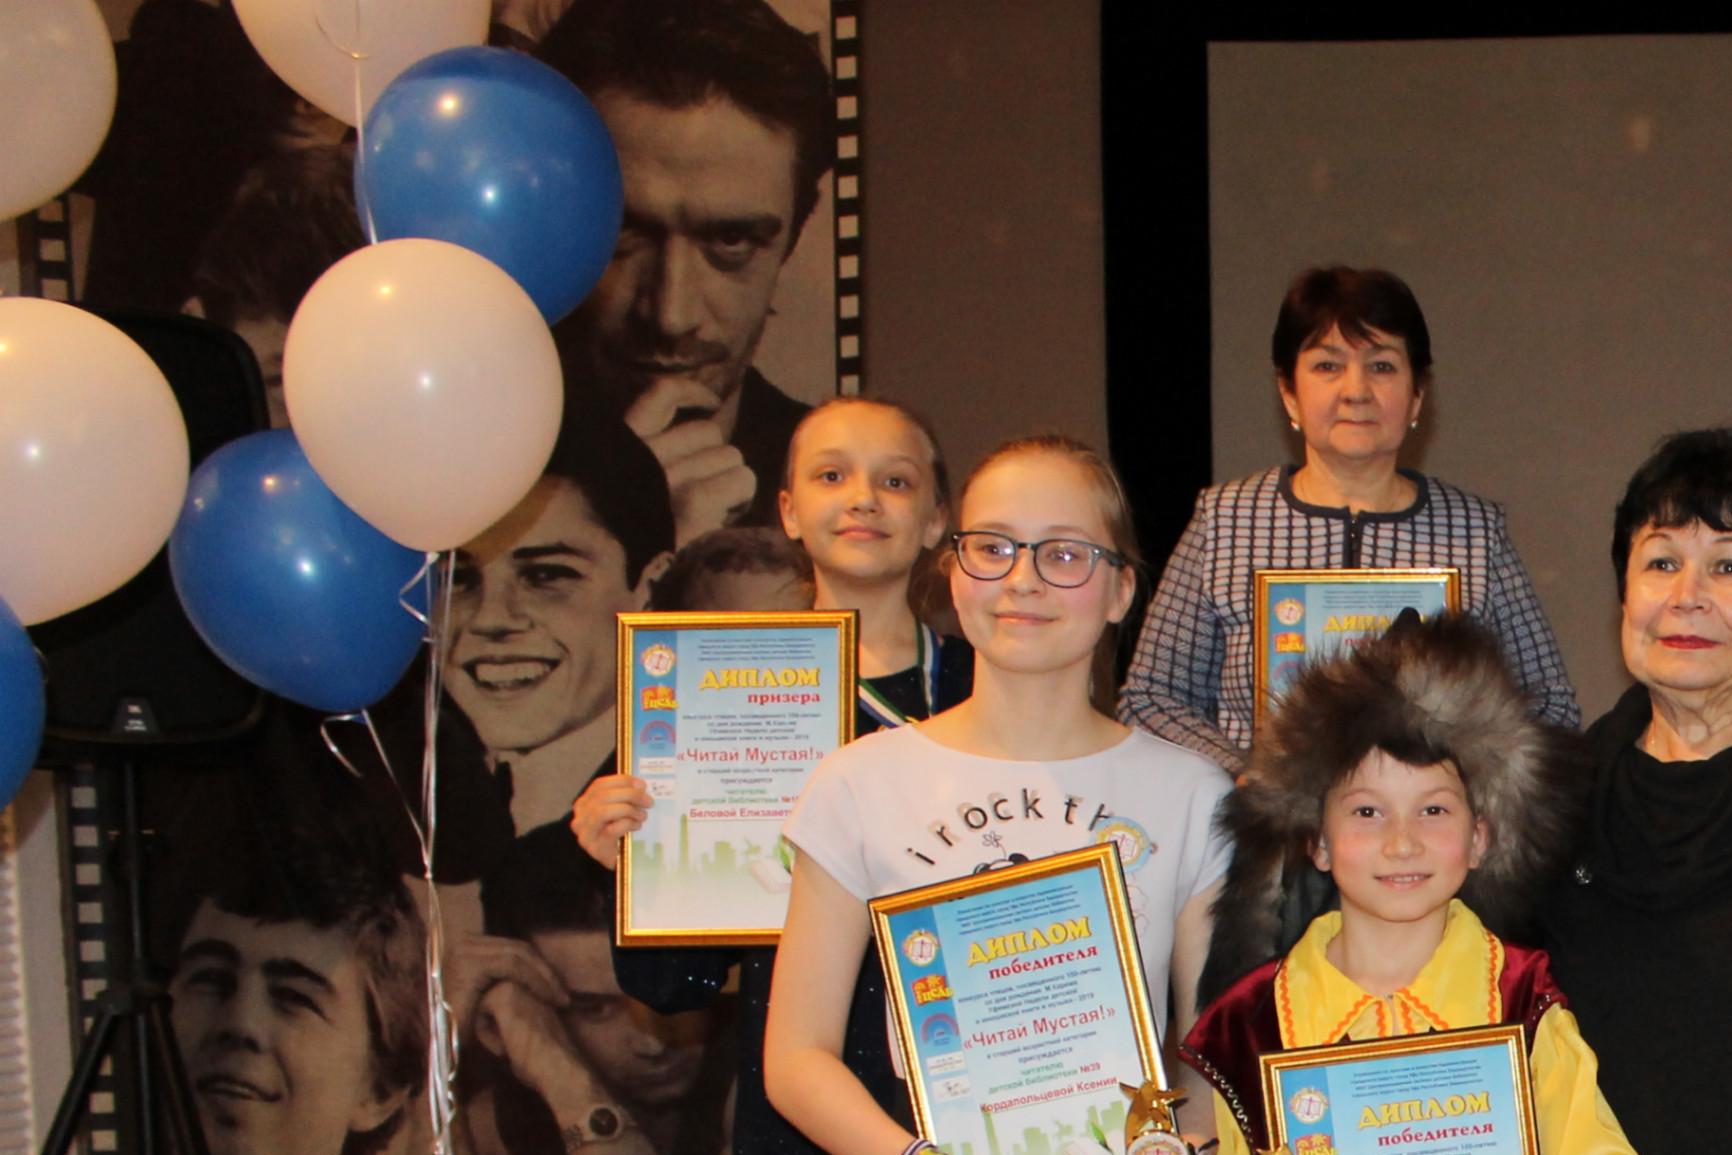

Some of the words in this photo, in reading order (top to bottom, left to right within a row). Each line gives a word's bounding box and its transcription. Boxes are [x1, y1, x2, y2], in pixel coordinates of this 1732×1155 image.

[699, 666, 820, 690] ДИПЛОМ
[747, 692, 820, 705] призера
[676, 748, 738, 761] «Читай
[745, 747, 824, 764] Мустая!»
[740, 808, 791, 817] Елизавет
[935, 787, 1044, 848] rock
[964, 918, 1093, 965] ДИПЛОМ
[987, 947, 1097, 979] победителя
[962, 1022, 1028, 1049] «Читай
[1031, 1003, 1117, 1037] Мустая!»
[1356, 1092, 1491, 1128] ДИПЛОМ
[1377, 1123, 1493, 1145] победителя
